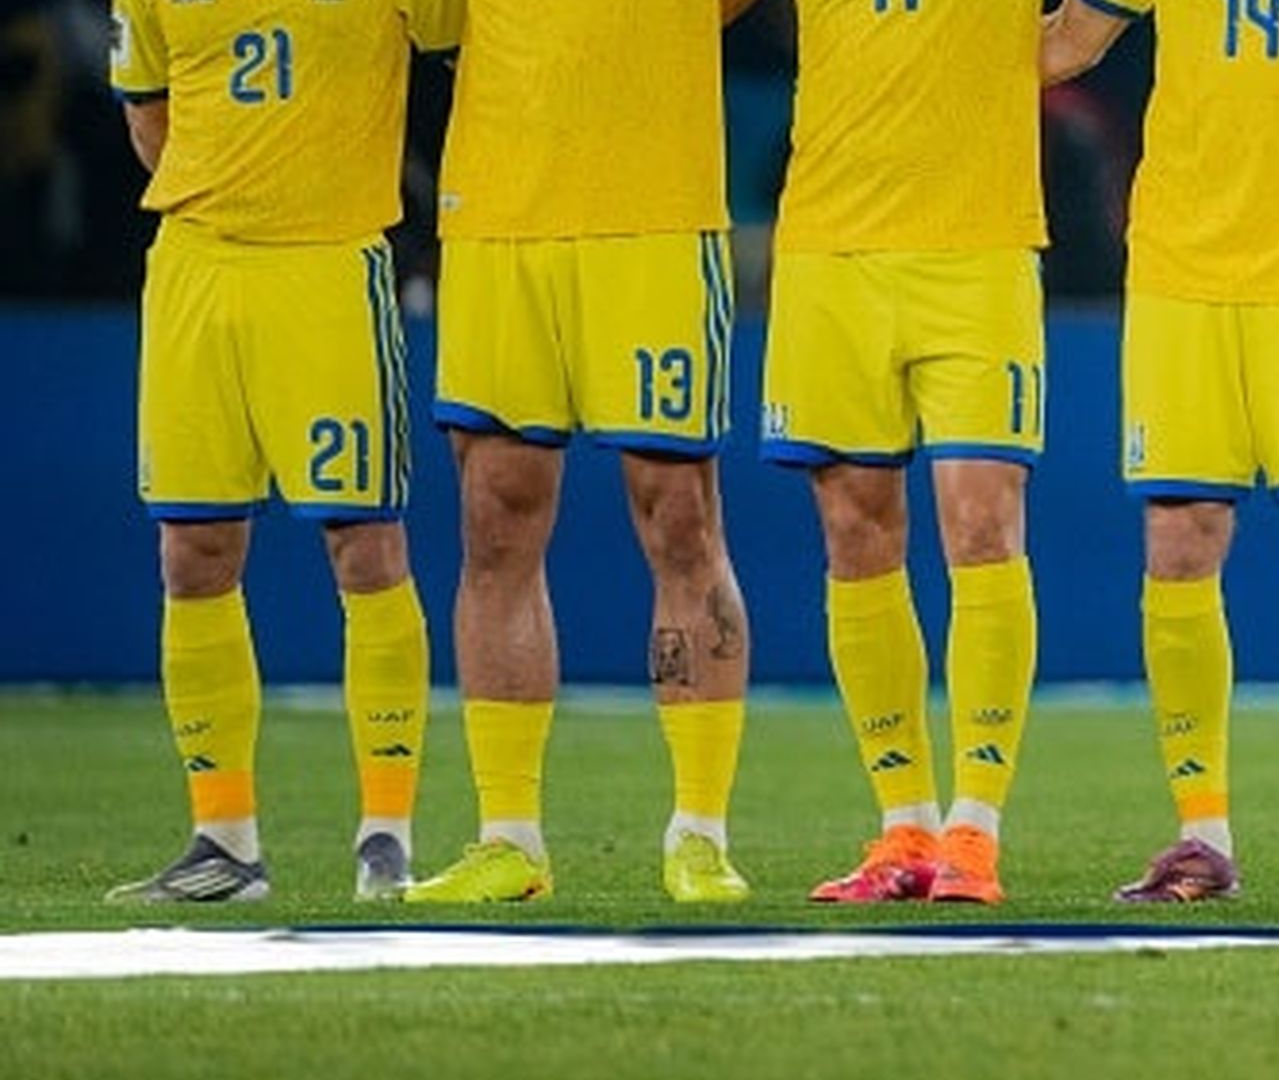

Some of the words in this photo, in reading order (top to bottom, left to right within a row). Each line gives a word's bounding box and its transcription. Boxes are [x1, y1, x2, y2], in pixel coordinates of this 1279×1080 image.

[229, 27, 293, 105] 21
[634, 347, 694, 423] 13
[1006, 360, 1042, 436] 11
[309, 416, 371, 494] 21
